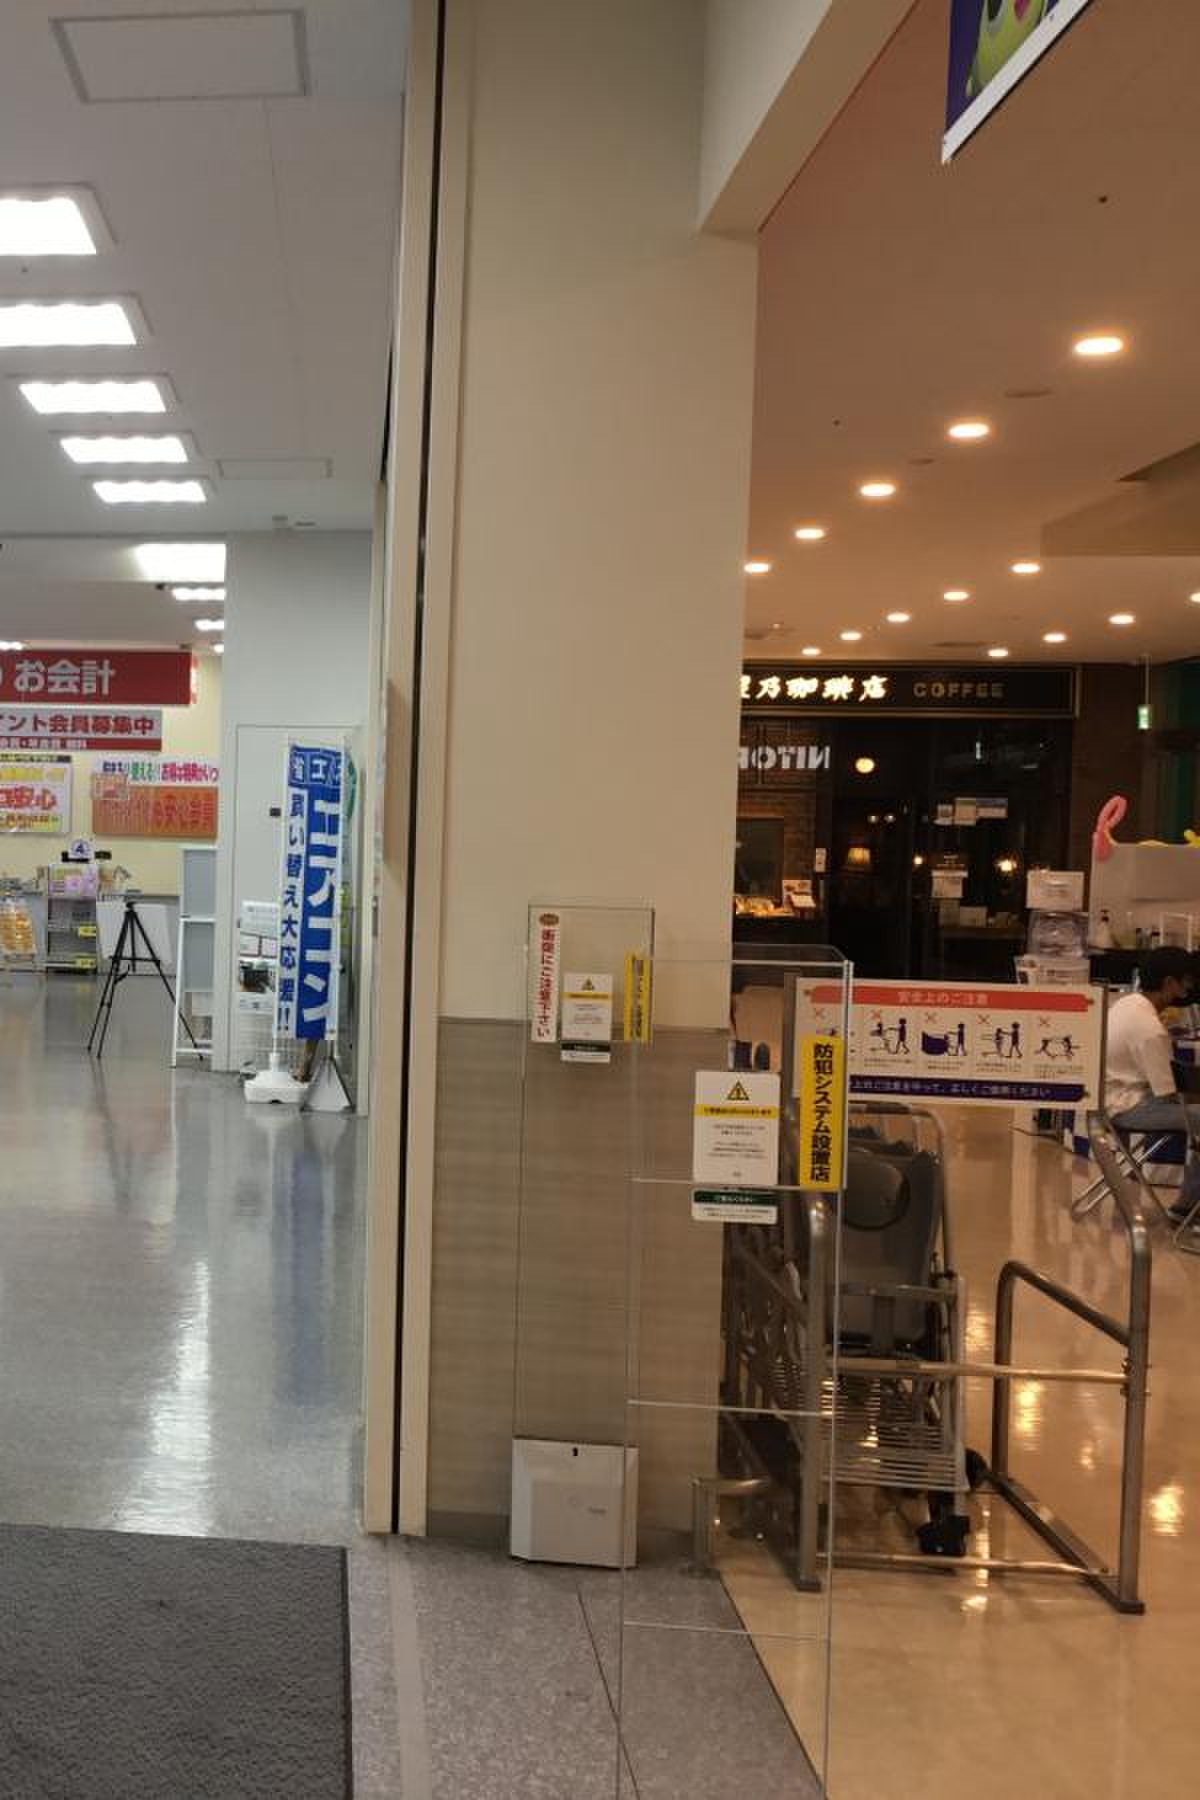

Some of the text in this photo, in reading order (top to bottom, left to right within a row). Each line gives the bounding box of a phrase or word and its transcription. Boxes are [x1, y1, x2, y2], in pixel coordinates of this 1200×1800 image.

[13, 659, 116, 695] お会計
[912, 682, 1005, 698] COFFEE
[811, 1042, 833, 1183] 防犯システム設置店
